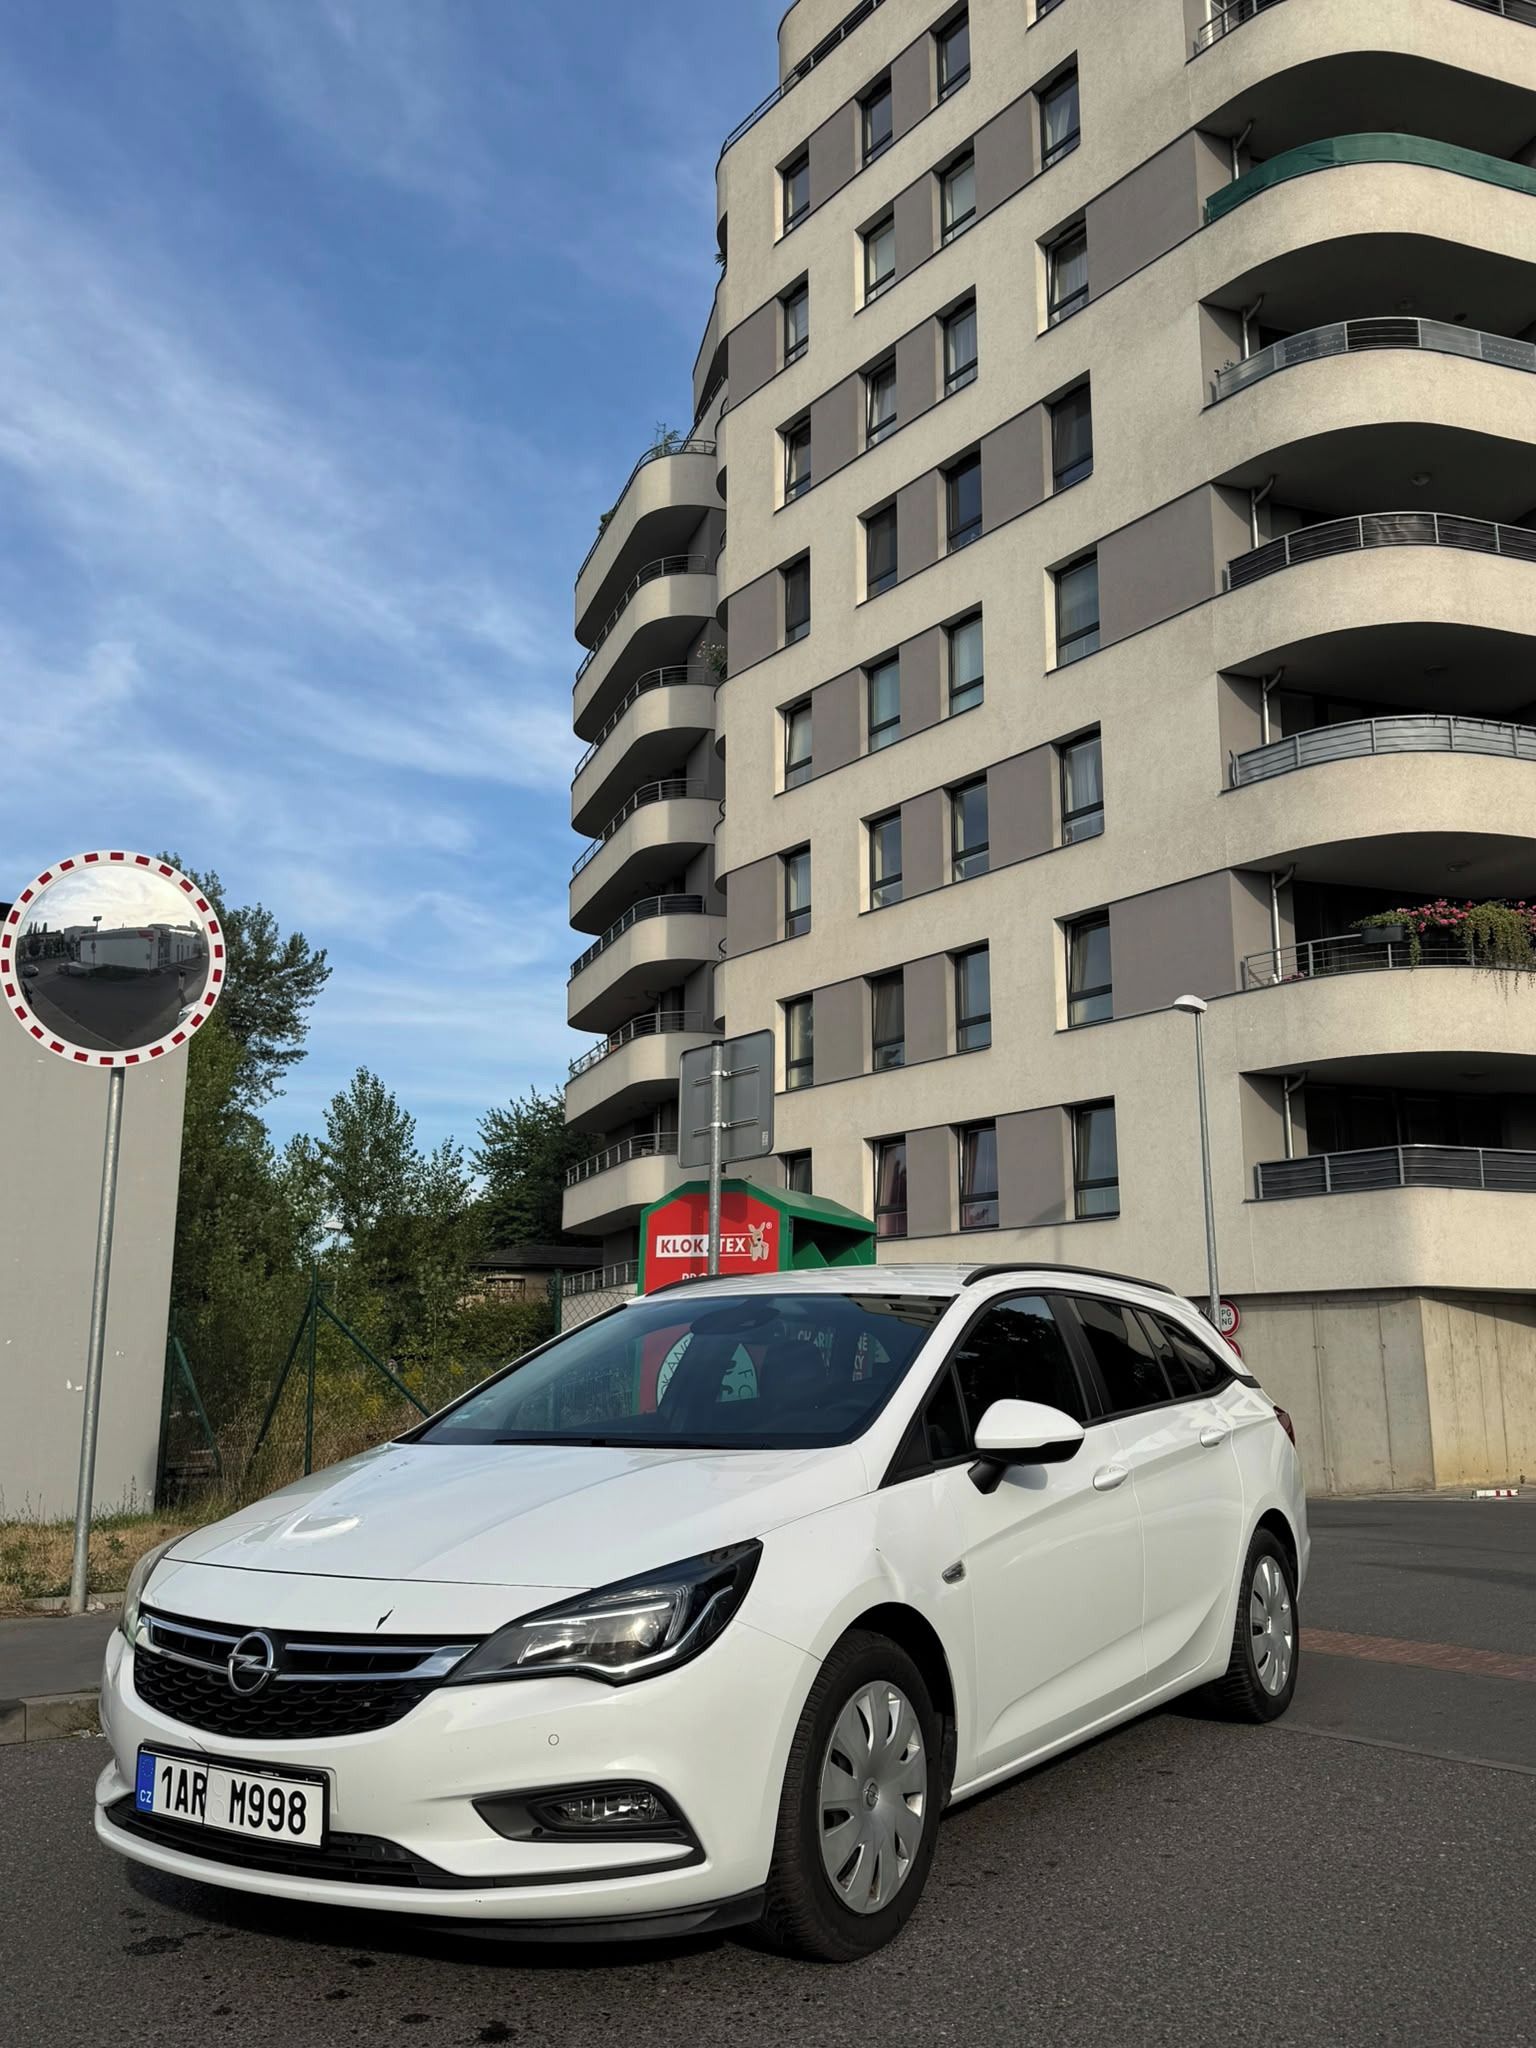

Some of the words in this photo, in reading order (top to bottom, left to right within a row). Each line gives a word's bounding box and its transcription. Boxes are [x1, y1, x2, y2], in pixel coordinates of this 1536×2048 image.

[660, 1237, 747, 1254] KLOKTEX
[140, 1789, 152, 1804] CZ
[161, 1765, 207, 1817] 1AR
[229, 1779, 307, 1835] M998
